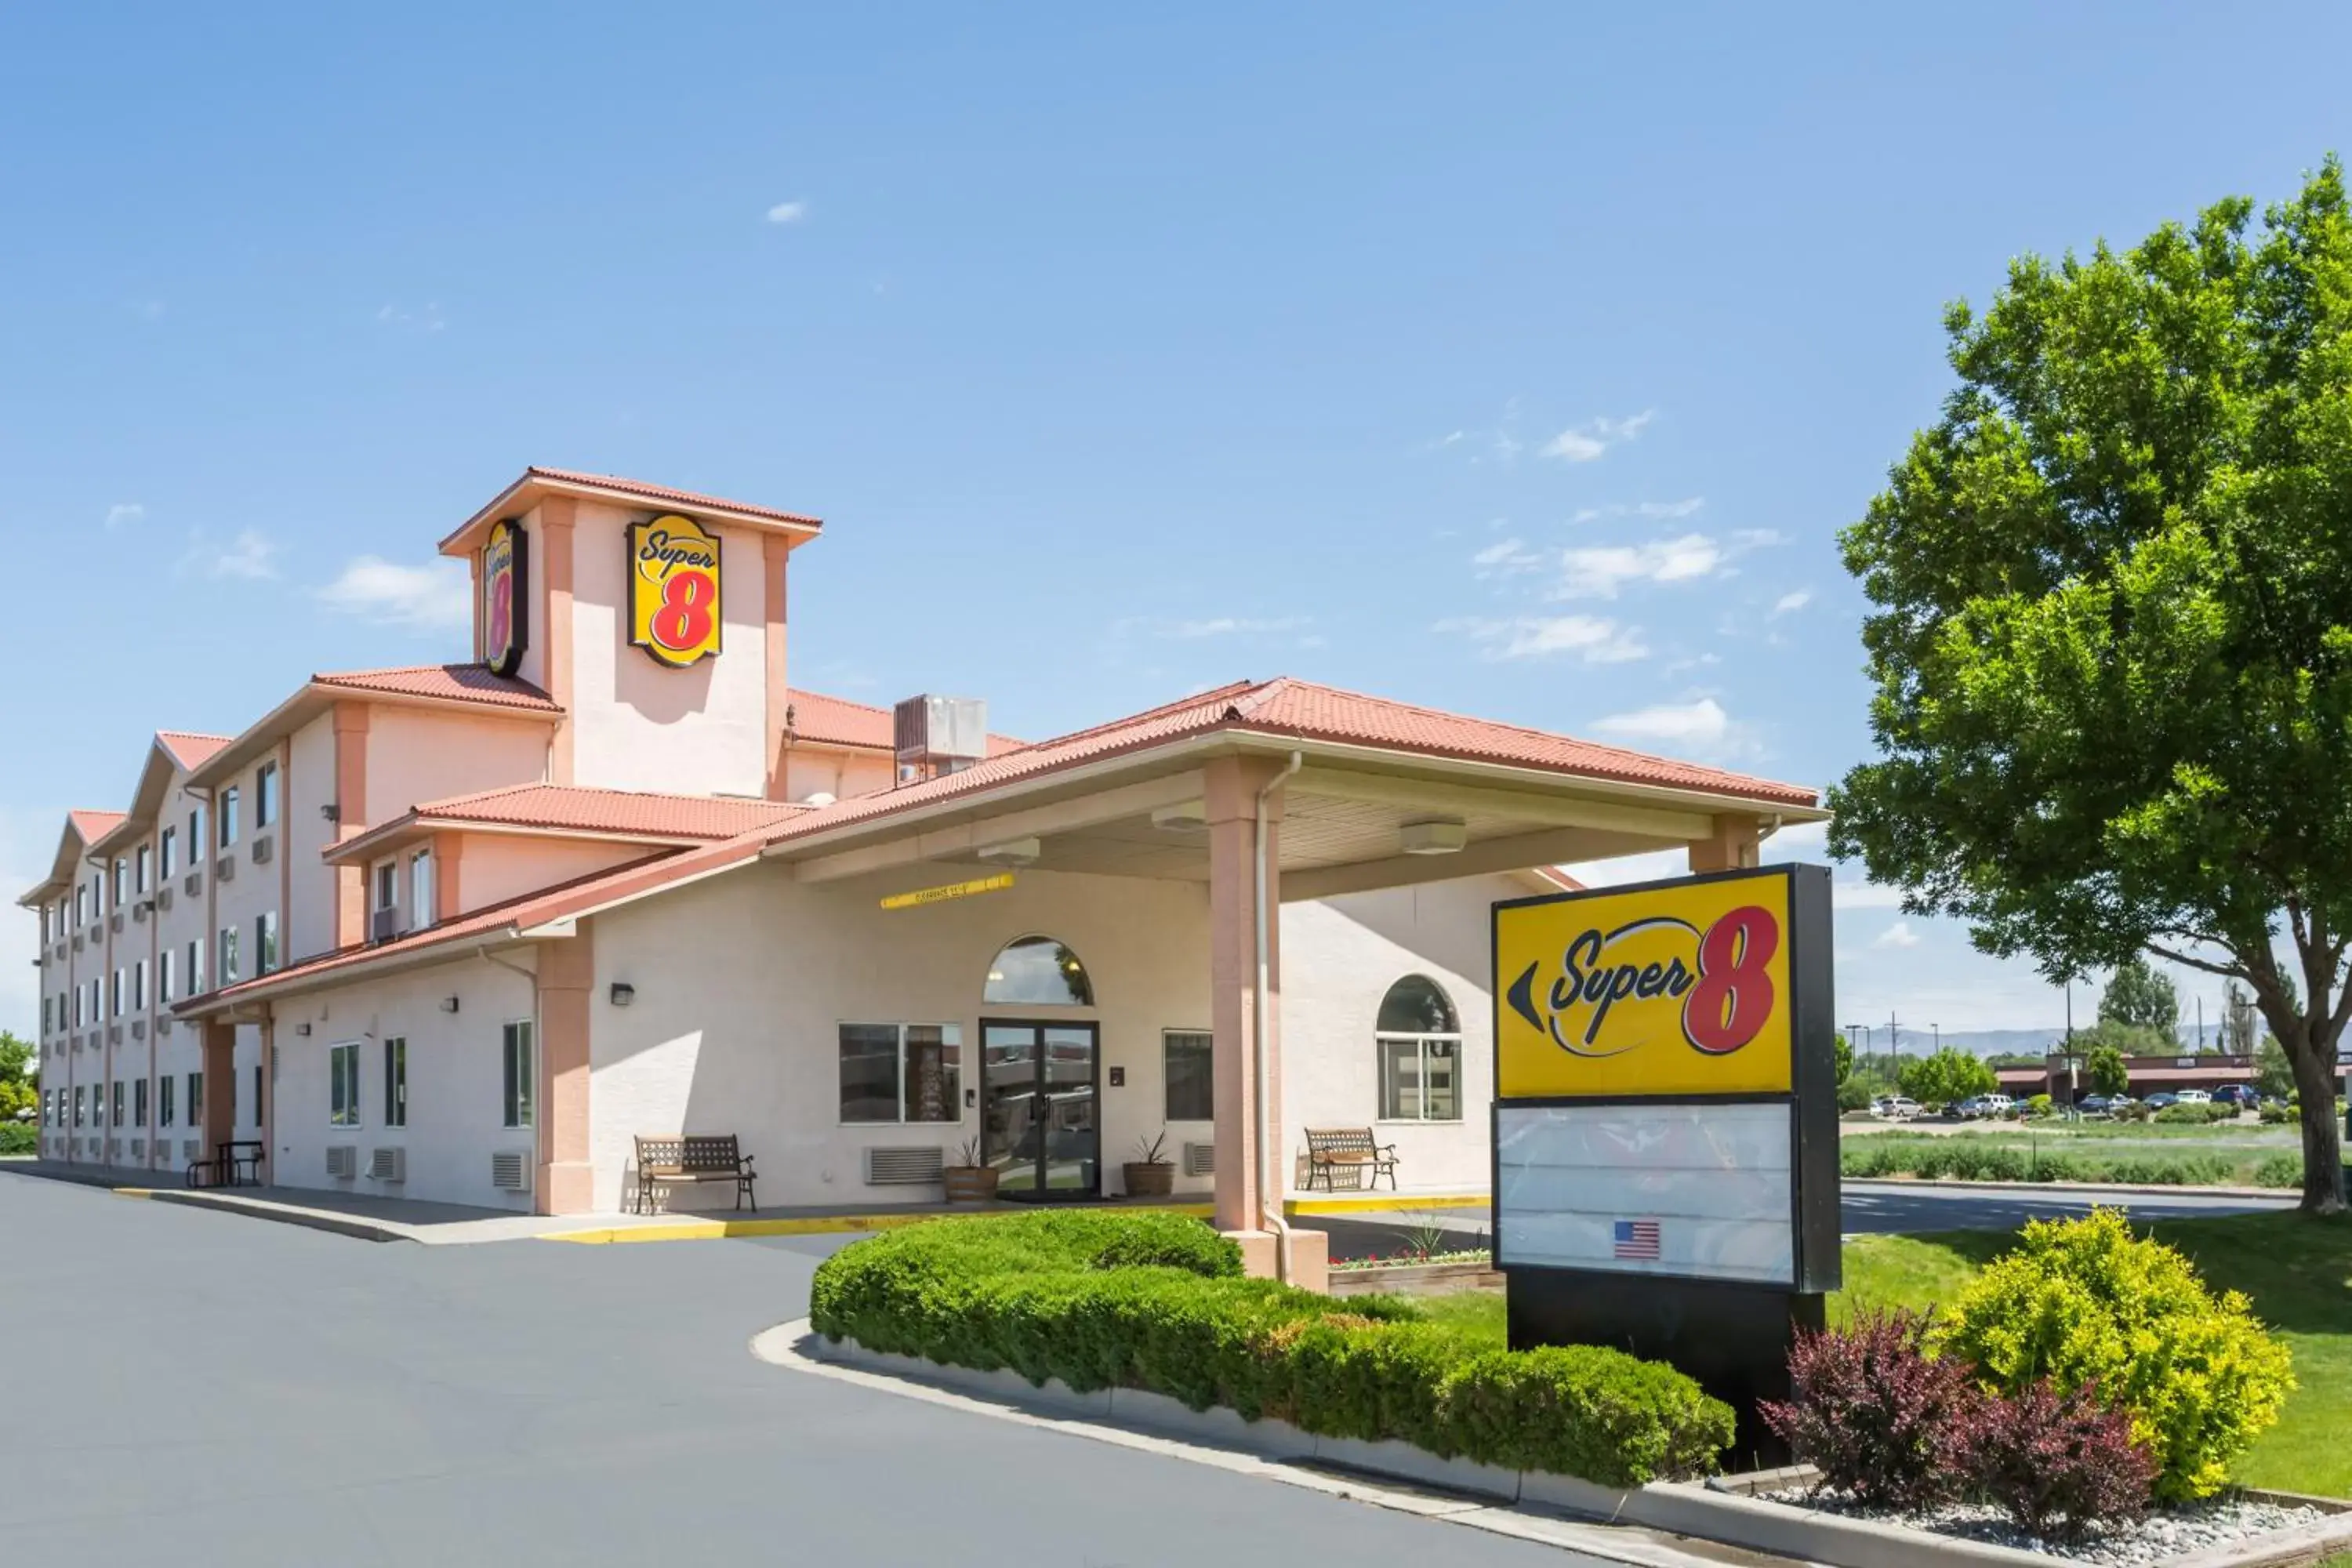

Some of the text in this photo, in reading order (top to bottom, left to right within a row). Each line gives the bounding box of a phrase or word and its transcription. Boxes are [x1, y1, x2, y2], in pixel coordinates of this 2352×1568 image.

[639, 530, 716, 579] Super
[648, 570, 716, 651] 8
[1550, 906, 1779, 1055] Super 8
